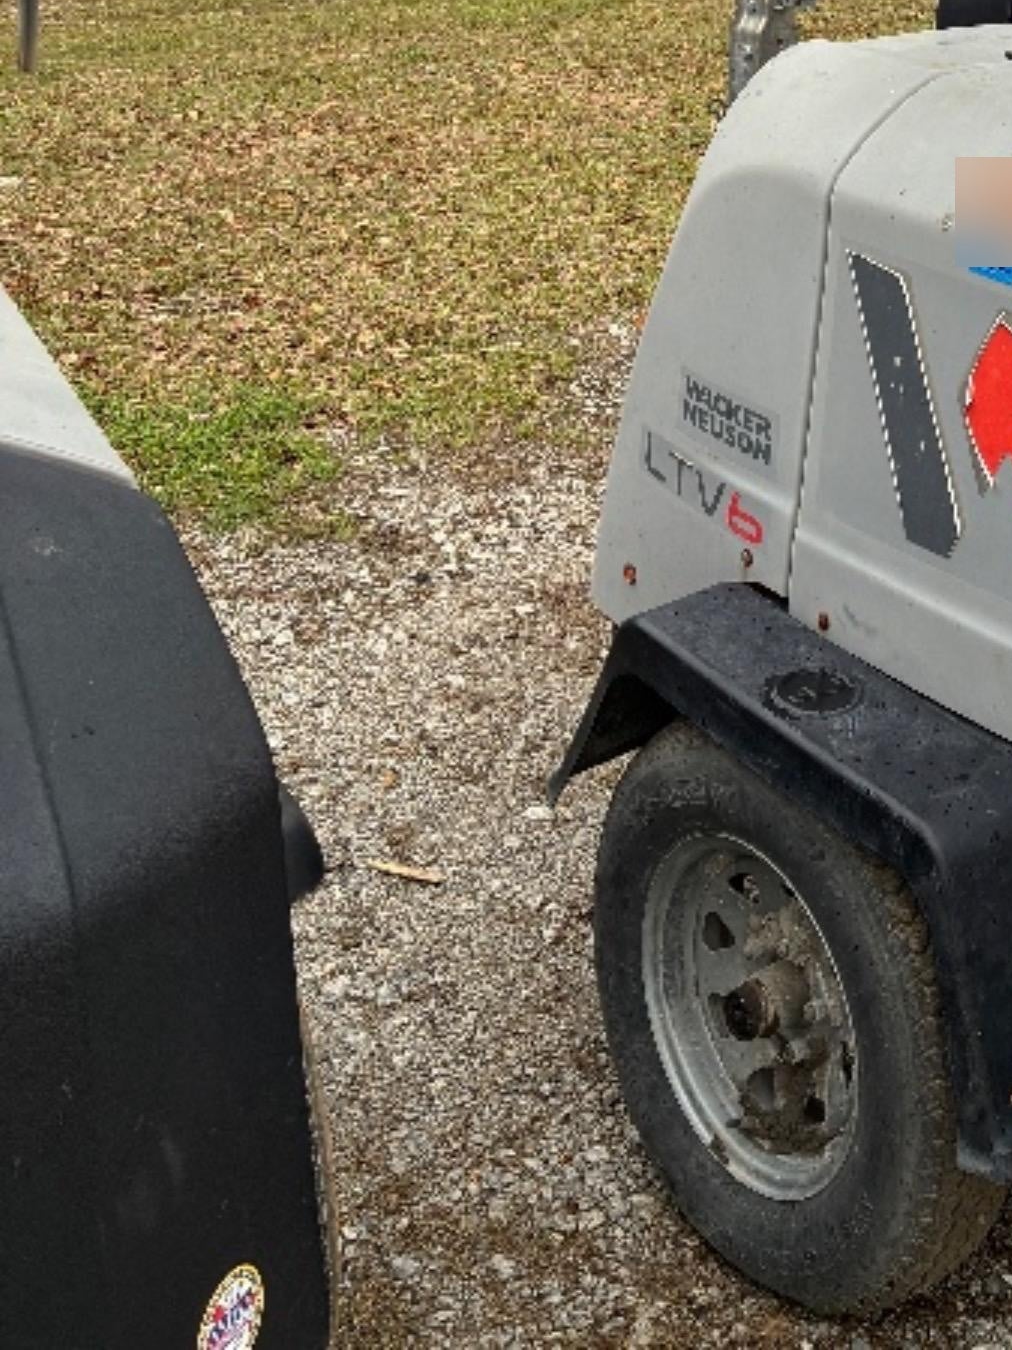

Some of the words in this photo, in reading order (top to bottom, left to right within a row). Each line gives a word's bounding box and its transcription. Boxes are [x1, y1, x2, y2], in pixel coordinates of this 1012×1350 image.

[682, 397, 772, 466] NEUSON
[685, 374, 772, 441] WACKER
[644, 430, 764, 545] LTV6
